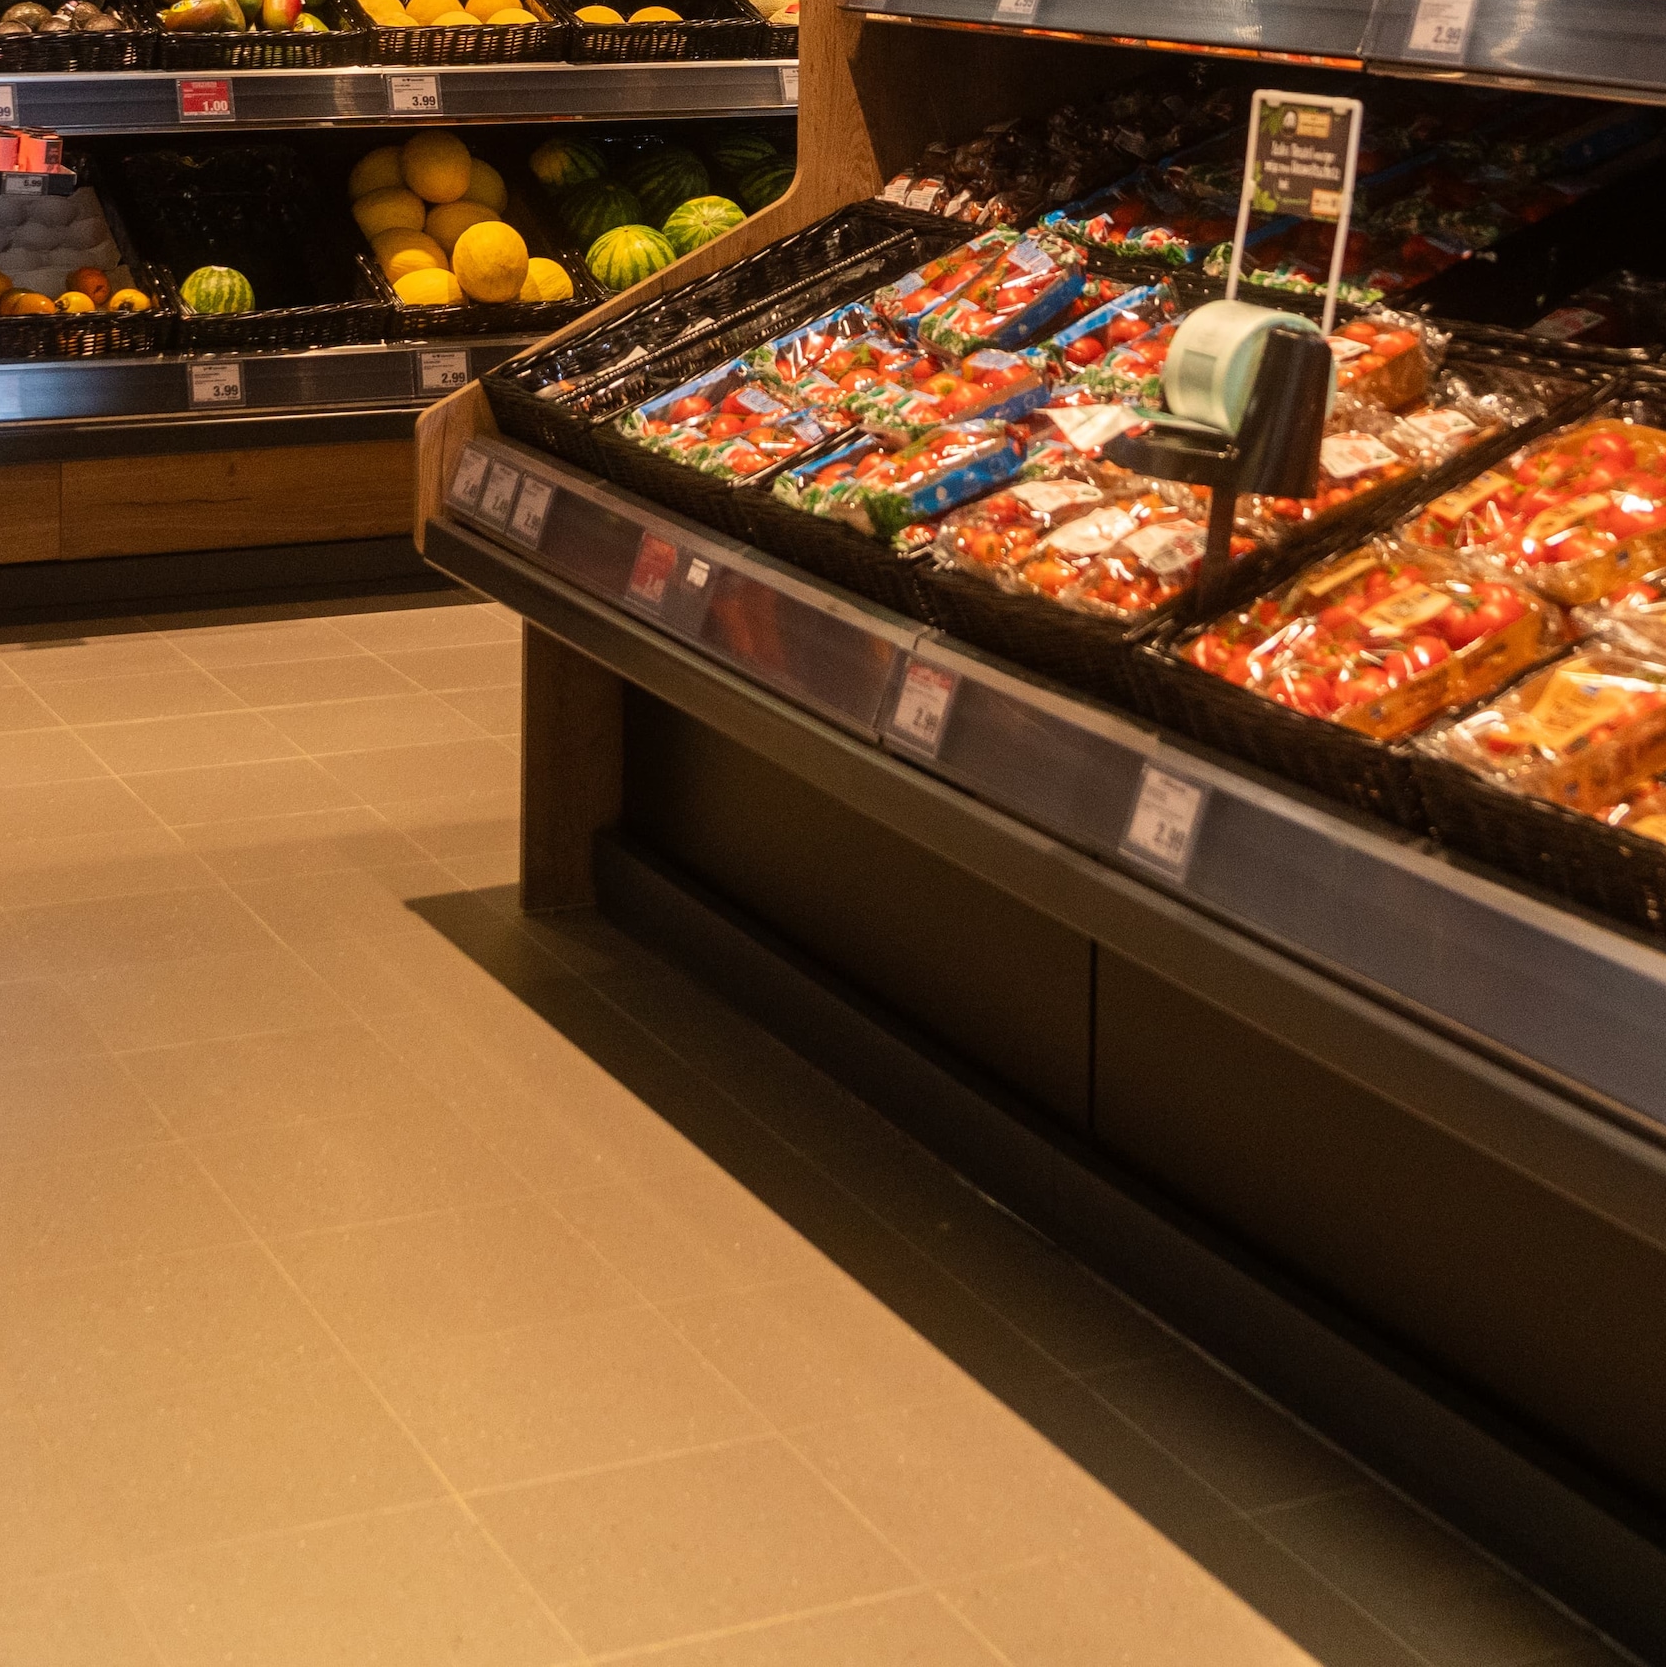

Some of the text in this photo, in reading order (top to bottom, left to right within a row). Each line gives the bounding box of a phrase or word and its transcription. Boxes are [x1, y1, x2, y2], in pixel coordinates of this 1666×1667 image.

[202, 100, 228, 111] 1.00
[412, 96, 436, 106] 3.99
[441, 373, 465, 384] 2.99
[213, 385, 239, 397] 3.99
